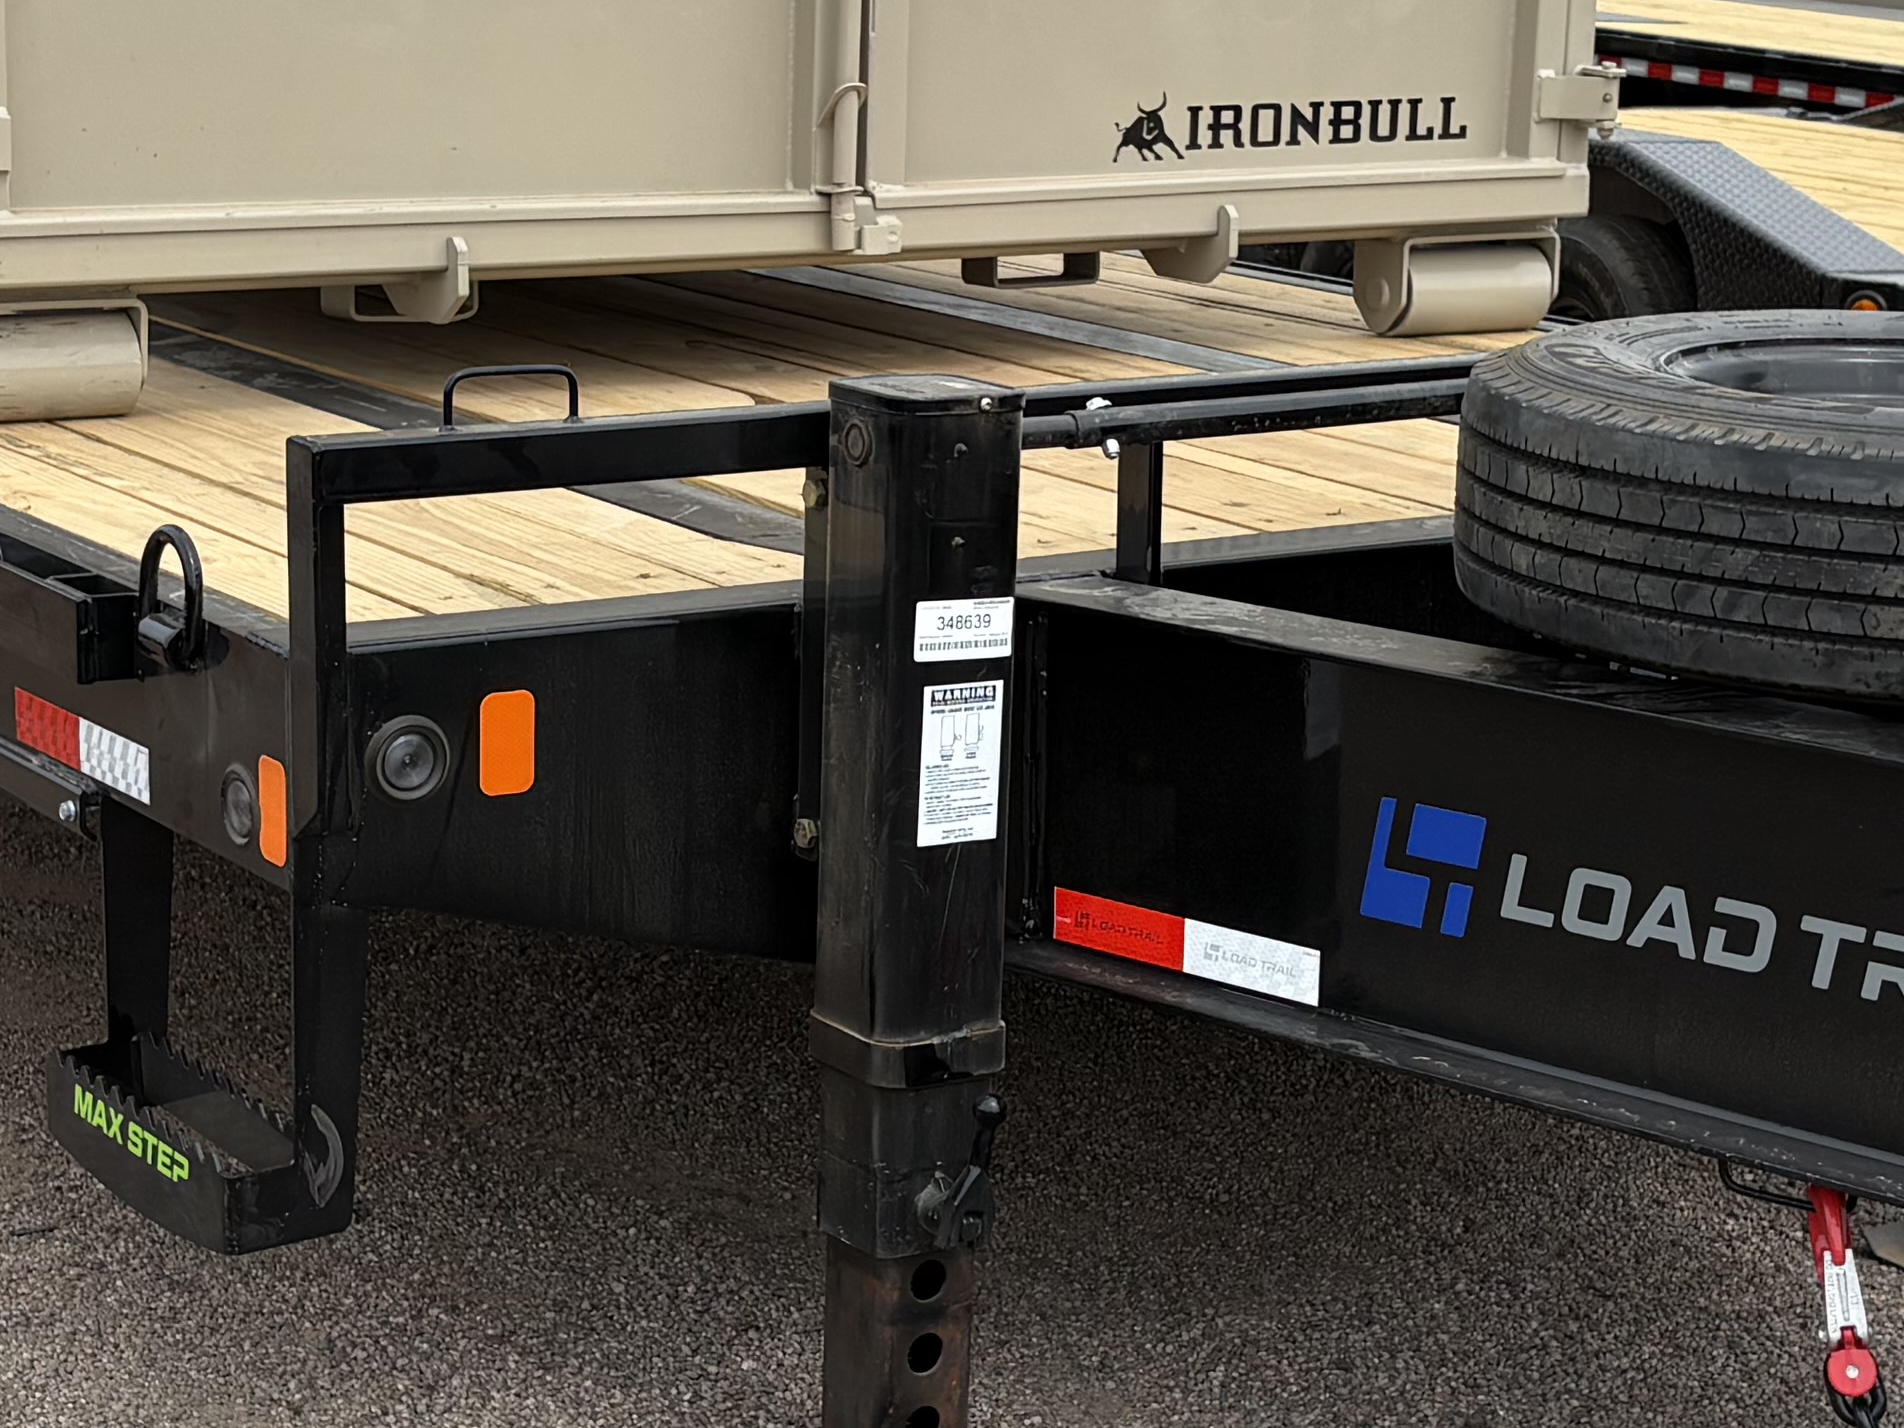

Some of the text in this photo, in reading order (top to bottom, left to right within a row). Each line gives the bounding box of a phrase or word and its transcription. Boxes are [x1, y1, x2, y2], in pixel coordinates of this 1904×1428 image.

[1185, 96, 1467, 151] IRONBULL
[936, 613, 992, 631] 348639
[933, 686, 994, 702] WARNING
[1500, 853, 1777, 974] LOAD
[1222, 951, 1296, 979] LOAD TRAIL
[74, 1083, 190, 1183] MAX STEP
